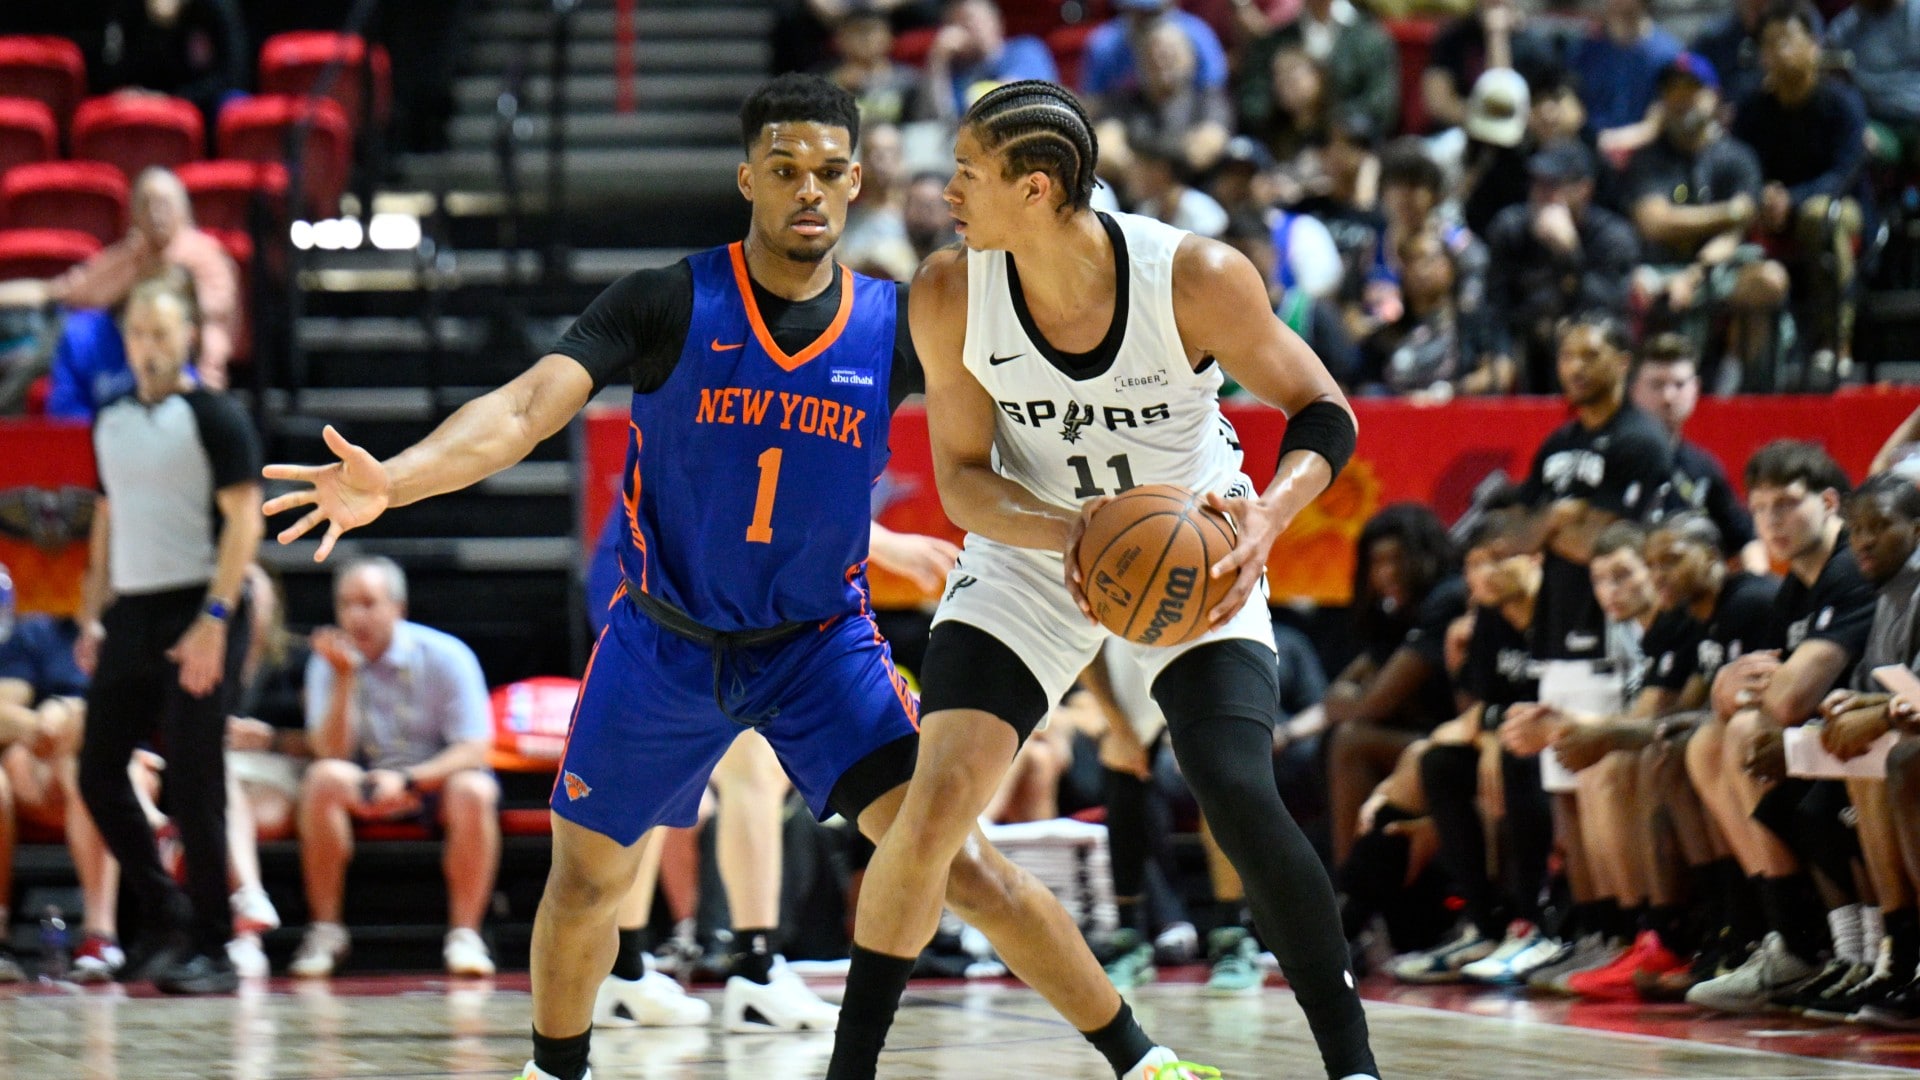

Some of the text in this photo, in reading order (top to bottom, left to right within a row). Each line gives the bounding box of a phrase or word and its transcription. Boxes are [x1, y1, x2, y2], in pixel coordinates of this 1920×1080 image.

[831, 374, 873, 385] abu dhabi
[1121, 374, 1161, 388] LEDGER
[695, 387, 866, 448] NEW YORK
[998, 400, 1171, 445] SPURS
[745, 447, 783, 544] 1
[1066, 453, 1144, 499] 11
[1137, 565, 1198, 645] Wilson
